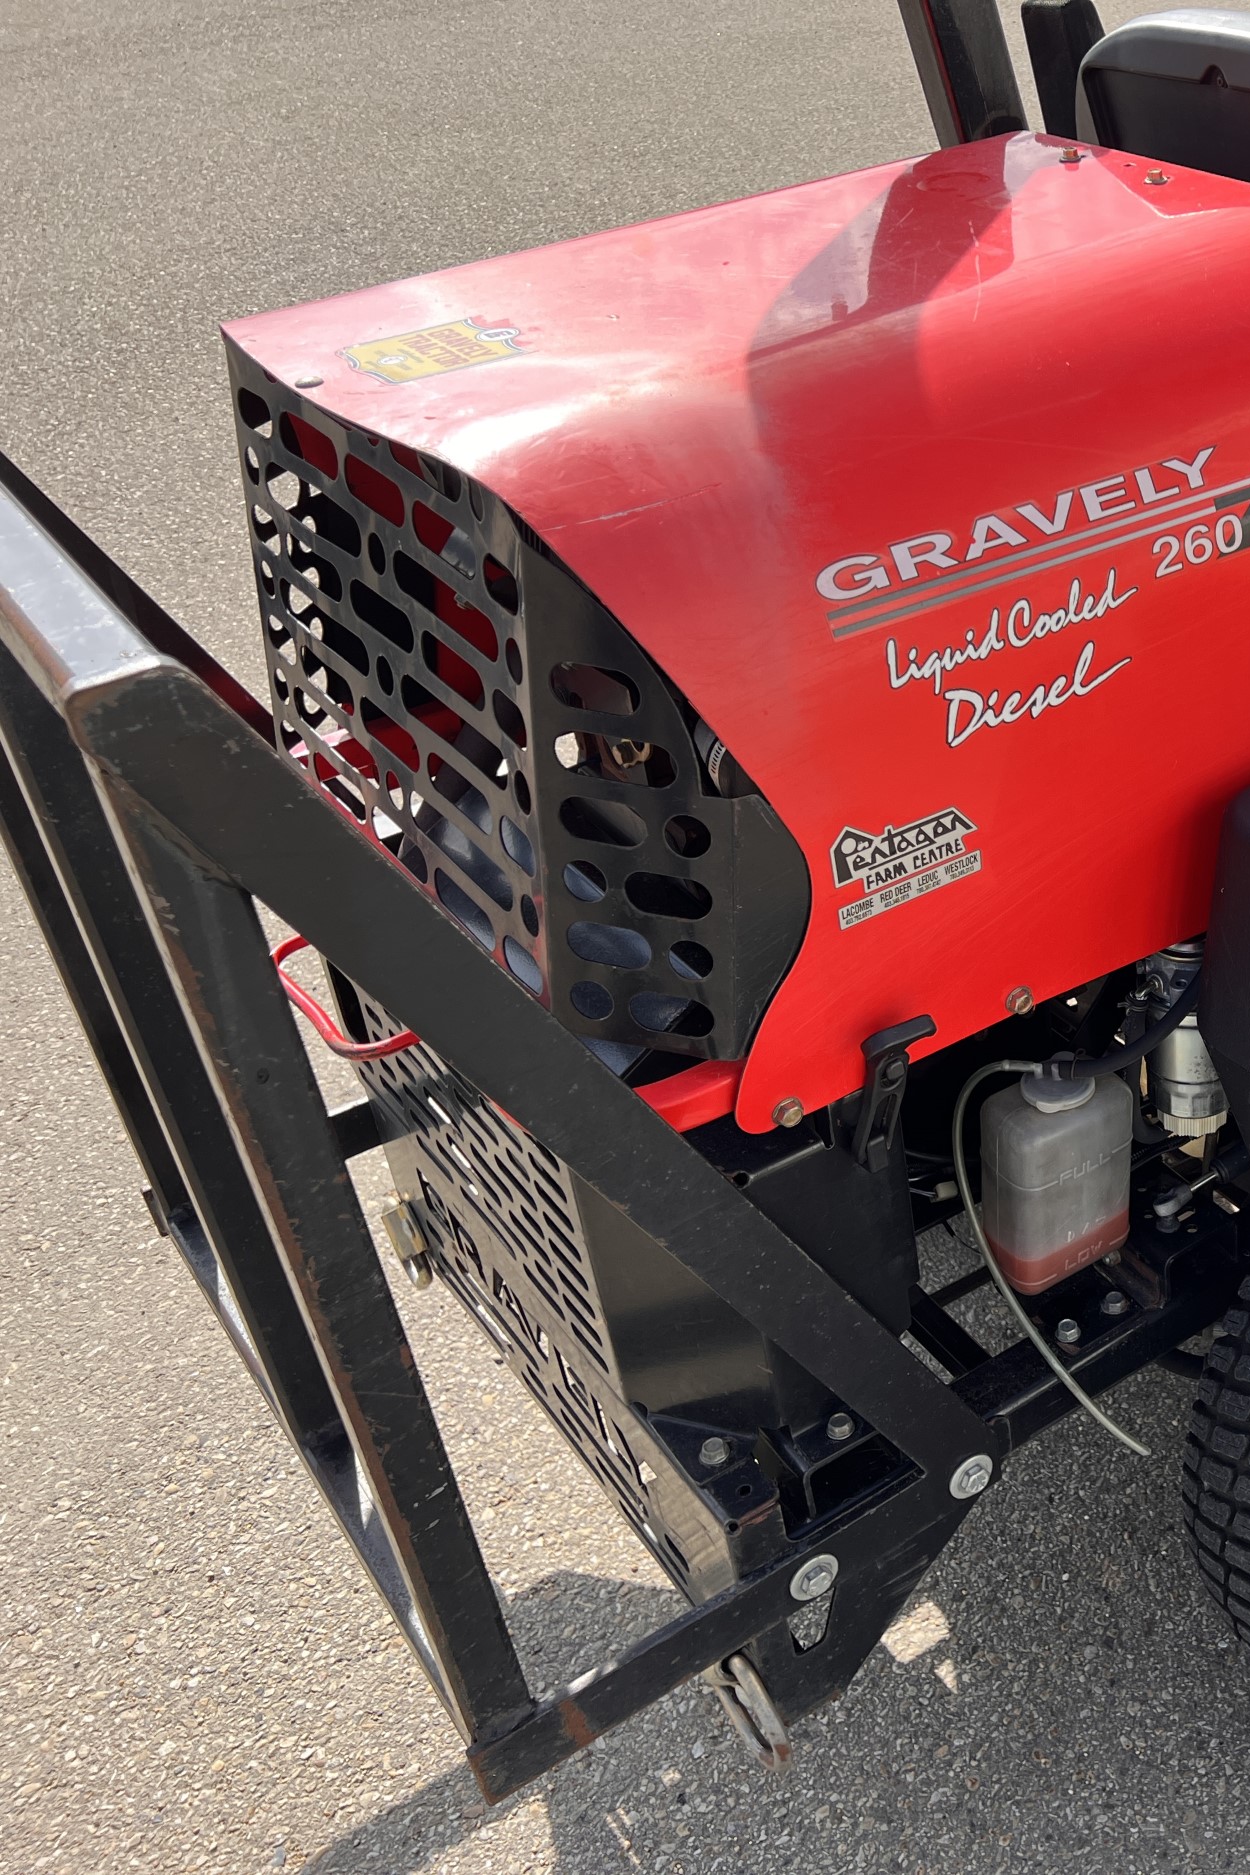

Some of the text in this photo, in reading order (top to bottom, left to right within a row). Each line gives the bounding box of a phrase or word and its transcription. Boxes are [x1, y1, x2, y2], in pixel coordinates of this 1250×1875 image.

[398, 334, 470, 368] TRACTOR
[424, 328, 498, 359] GRAVELY
[815, 445, 1217, 601] GRAVELY
[886, 568, 1138, 694] Liquid Cooled
[945, 641, 1133, 748] Diesel
[834, 809, 974, 885] Pentagon
[866, 838, 963, 890] FARM CENTRE
[841, 853, 979, 920] LACOMBE RED DEER LEDUC WESTLOCK
[1058, 1152, 1112, 1187] FULL
[1064, 1240, 1104, 1271] LOW
